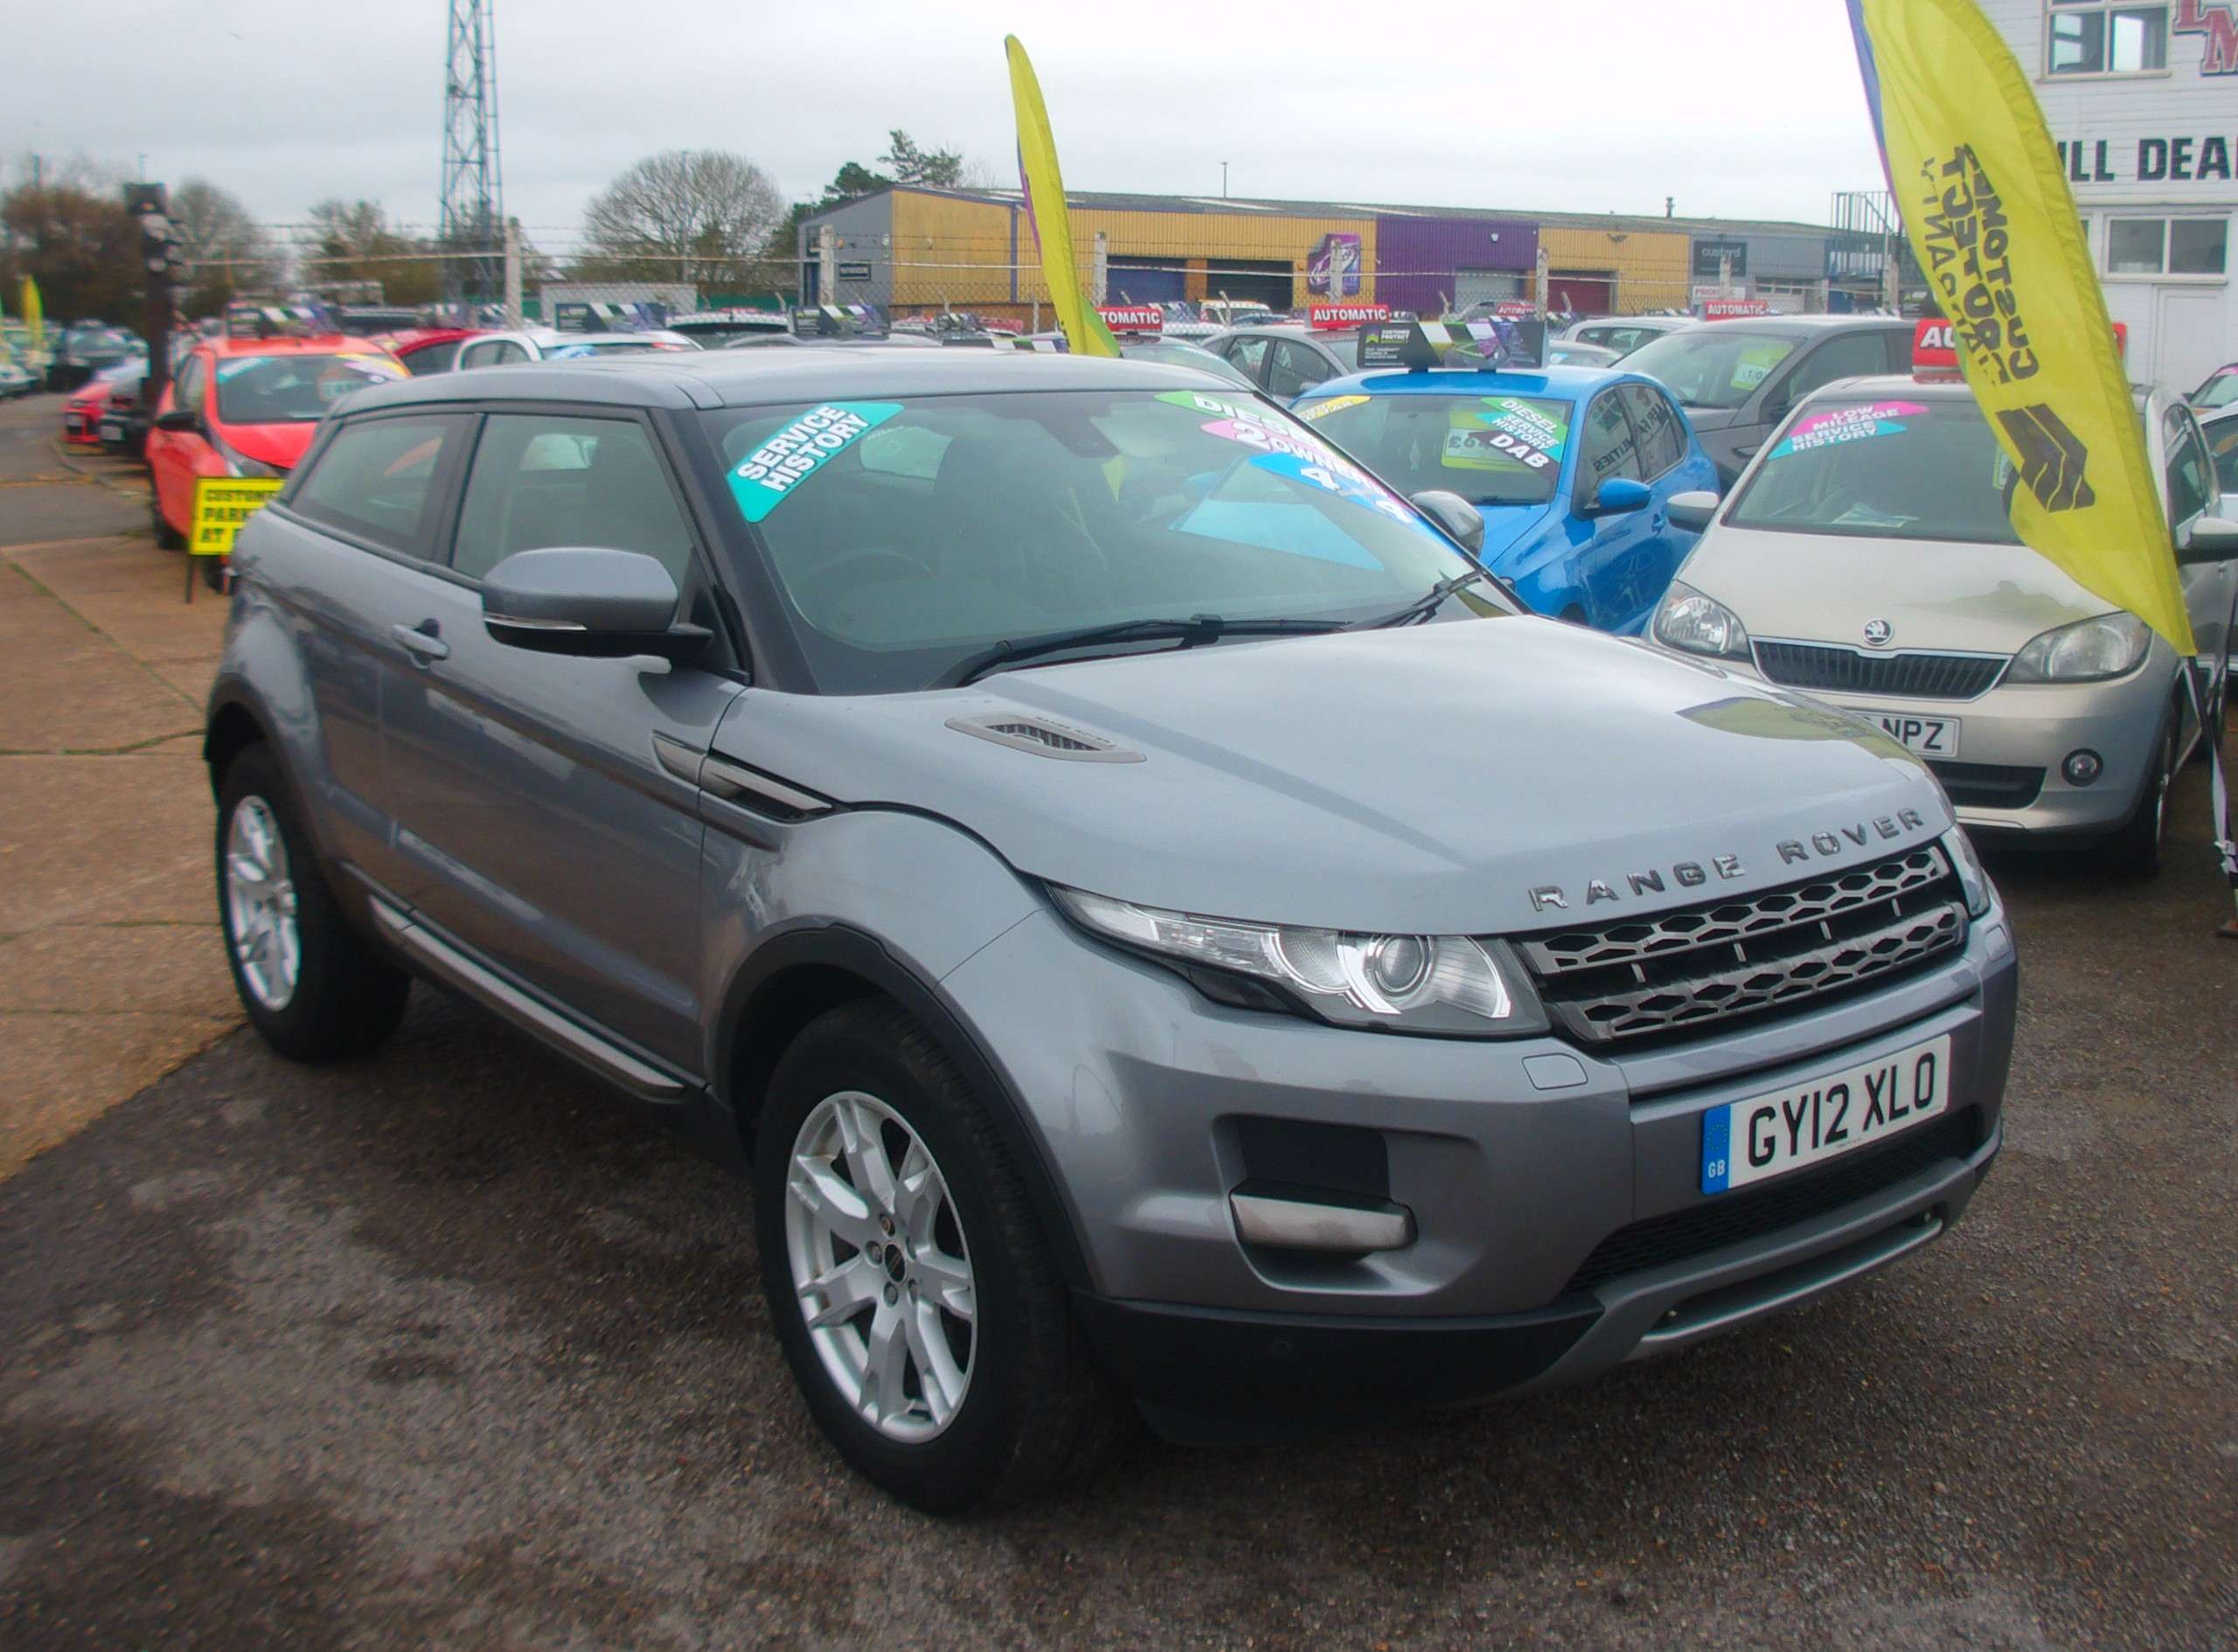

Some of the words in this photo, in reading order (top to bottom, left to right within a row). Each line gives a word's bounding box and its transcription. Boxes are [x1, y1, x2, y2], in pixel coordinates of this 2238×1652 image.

[2137, 137, 2238, 182] DEA
[1313, 309, 1387, 321] AUTOMATIC
[1707, 303, 1766, 316] AUTOMATIC
[1499, 399, 1558, 434] DIESEL
[1812, 408, 1900, 431] MILEAGE
[1832, 406, 1874, 420] LOW
[738, 406, 847, 480] SERVICE
[1492, 418, 1550, 450] HISTORY
[1503, 413, 1560, 448] SERVICE
[1792, 420, 1876, 443] SERVICE
[1792, 427, 1877, 451] HISTORY
[760, 413, 870, 492] HISTORY
[1489, 433, 1550, 469] DAB
[1527, 853, 1748, 912] RANGE
[1776, 807, 1925, 865] ROVER
[1748, 1083, 1850, 1169] GY12
[1862, 1052, 1936, 1133] XLO
[1707, 1159, 1727, 1179] GB
